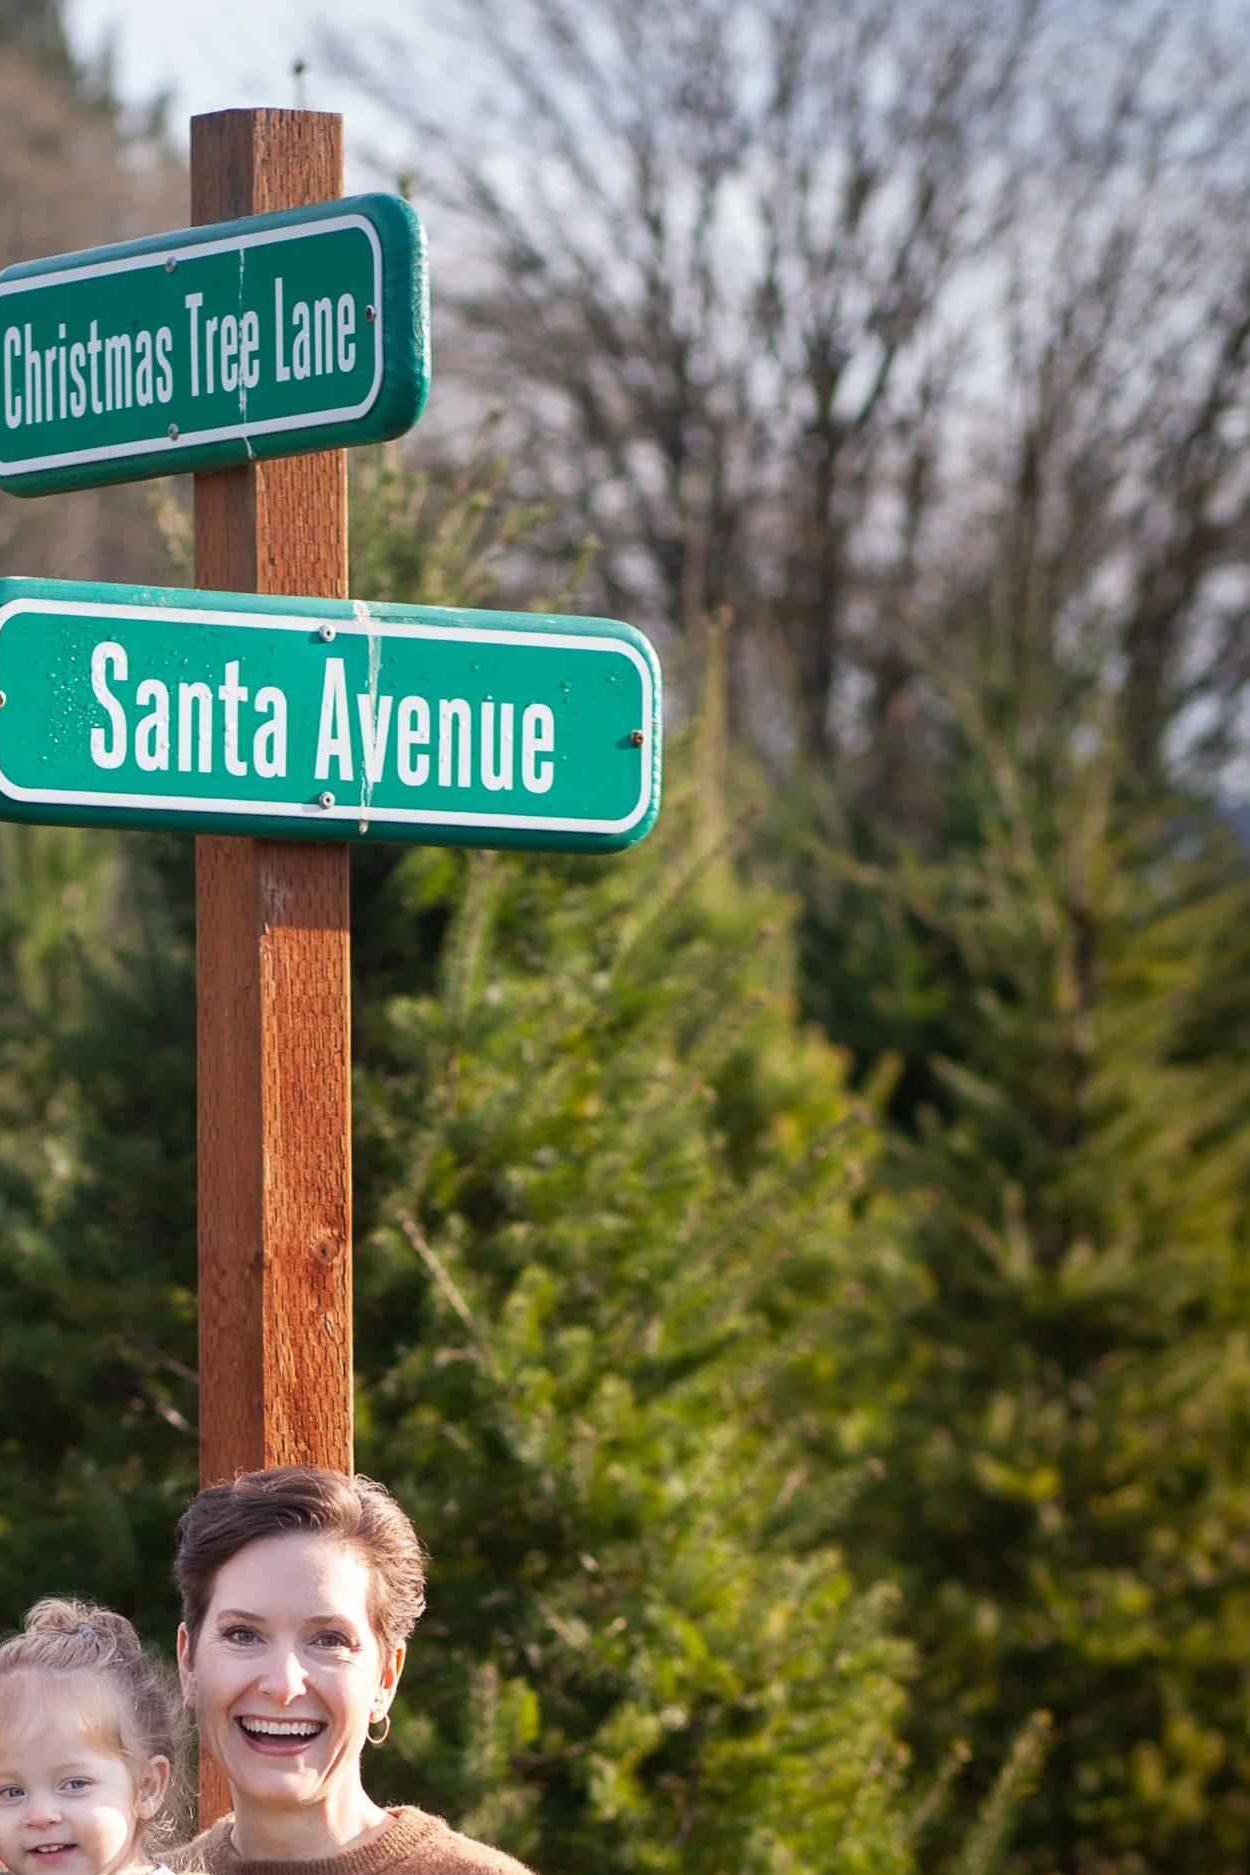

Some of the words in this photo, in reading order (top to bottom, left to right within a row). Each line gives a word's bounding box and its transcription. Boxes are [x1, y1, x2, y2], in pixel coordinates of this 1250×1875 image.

[4, 320, 174, 429] Christmas
[185, 292, 260, 397] Tree
[275, 277, 356, 383] Lane
[90, 640, 287, 778] Santa
[314, 657, 555, 793] Avenue
